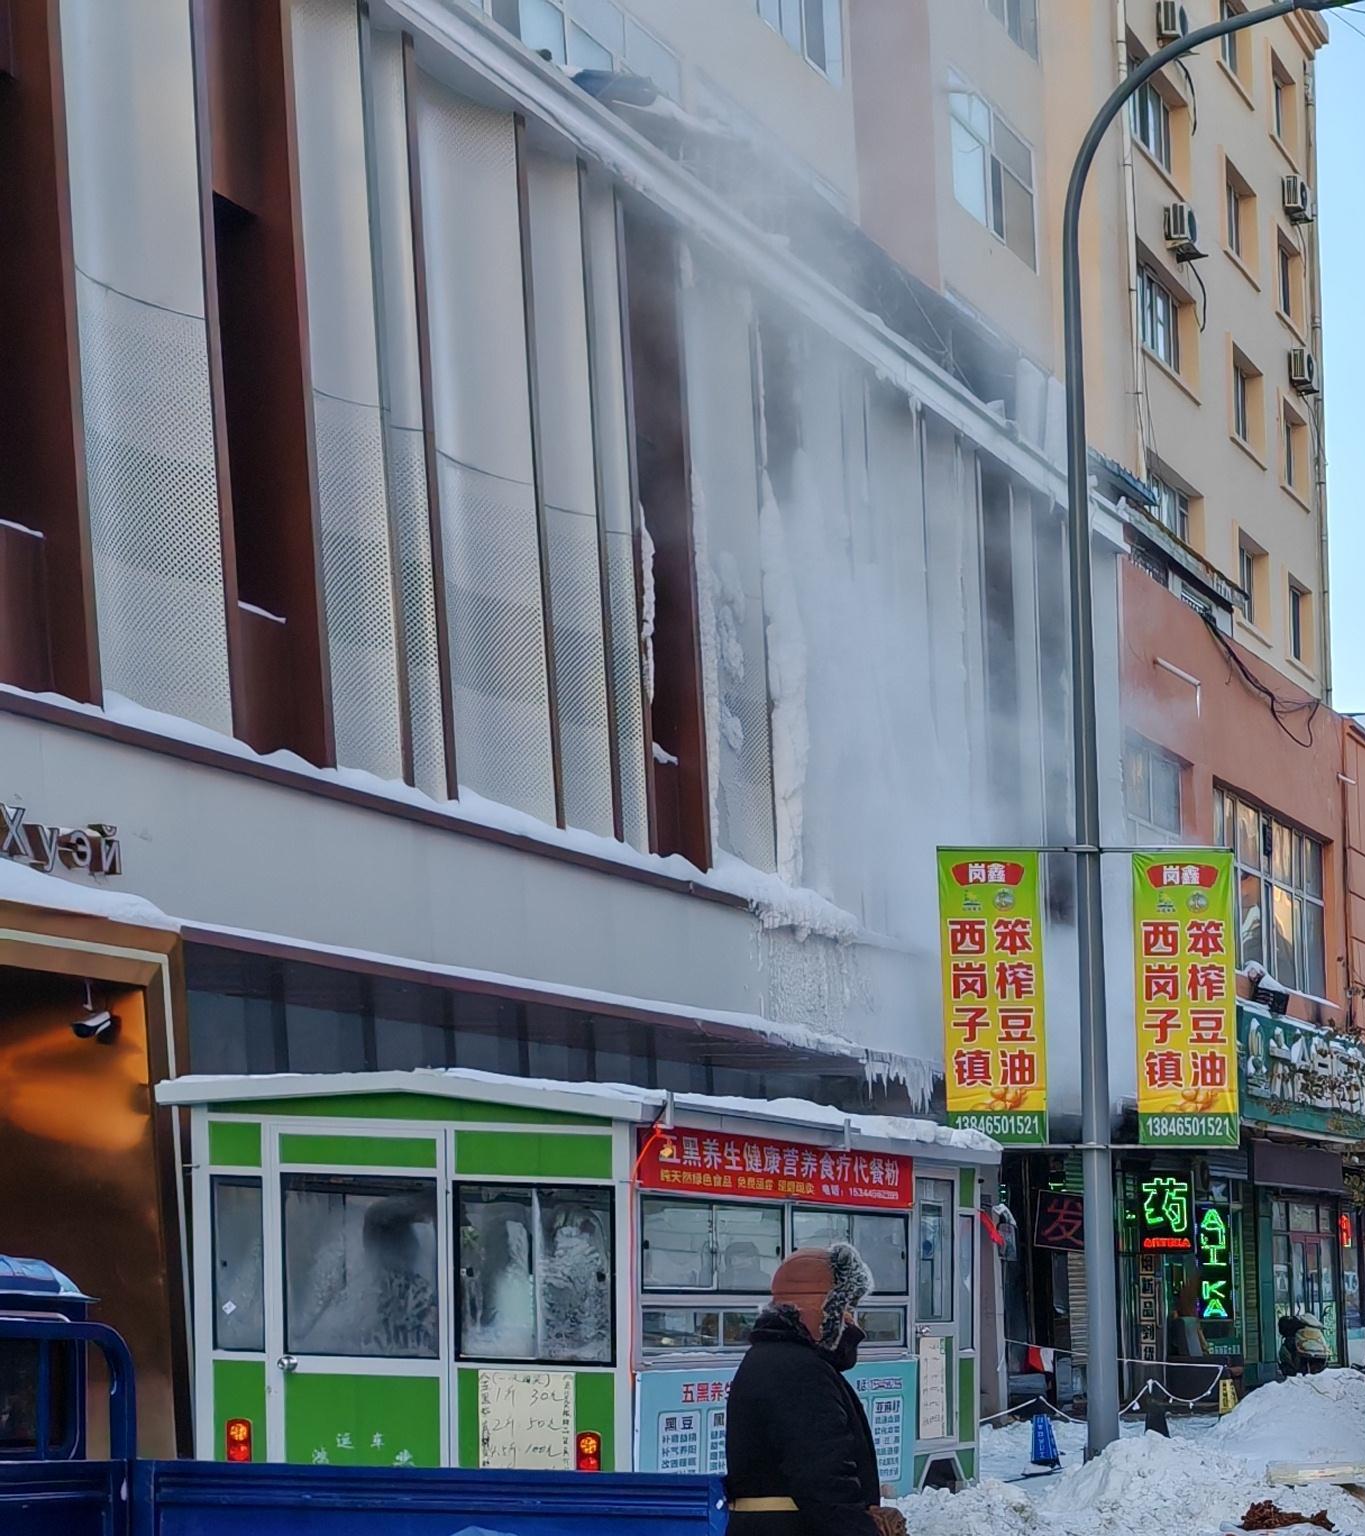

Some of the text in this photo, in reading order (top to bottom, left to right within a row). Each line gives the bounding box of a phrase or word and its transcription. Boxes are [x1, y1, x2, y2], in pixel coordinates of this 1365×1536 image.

[968, 863, 1007, 883] 岗鑫
[1162, 865, 1201, 886] 岗鑫
[948, 919, 992, 1088] 西岗子镇
[993, 918, 1037, 1088] 笨榨豆油
[1142, 921, 1183, 1089] 西岗子镇
[1187, 920, 1227, 1089] 笨榨豆油
[955, 1113, 1039, 1136] 13846501521
[1146, 1116, 1230, 1137] 13846501521
[1142, 1177, 1188, 1233] 药
